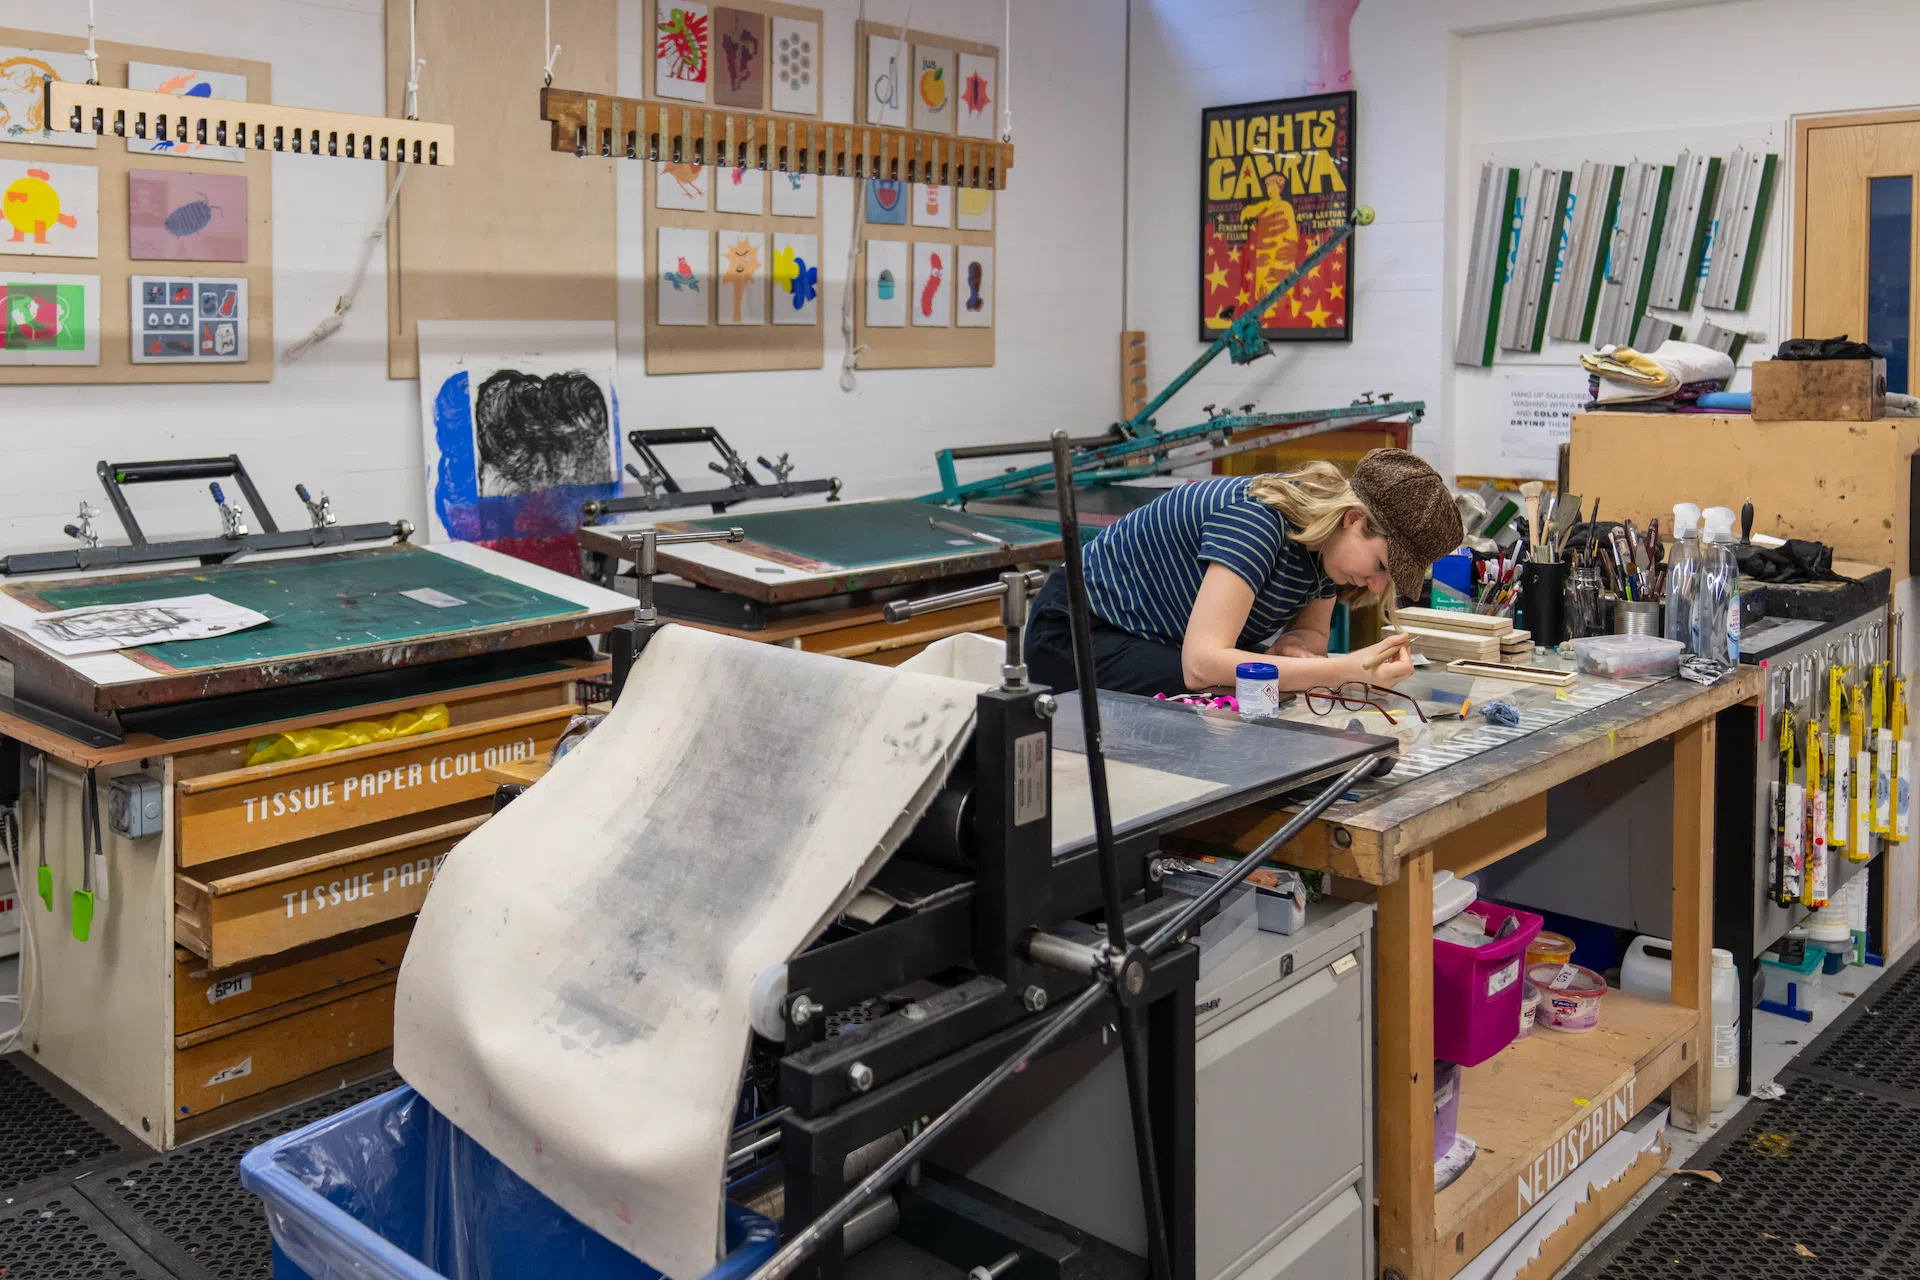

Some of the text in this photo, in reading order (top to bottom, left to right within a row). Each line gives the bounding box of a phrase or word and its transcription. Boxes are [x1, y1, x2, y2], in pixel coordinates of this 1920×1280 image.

[922, 56, 936, 70] jus
[1208, 110, 1336, 158] NIGHTS
[1208, 149, 1347, 200] CABIRIA
[1510, 419, 1546, 427] DRYING
[1513, 400, 1548, 408] WASHING
[1550, 400, 1569, 408] WITH
[1534, 410, 1559, 418] COLD
[243, 737, 536, 823] TISSUE PAPER (COLOUR)
[282, 872, 375, 918] TISSUE
[1517, 1077, 1637, 1217] NEWSPRINT
